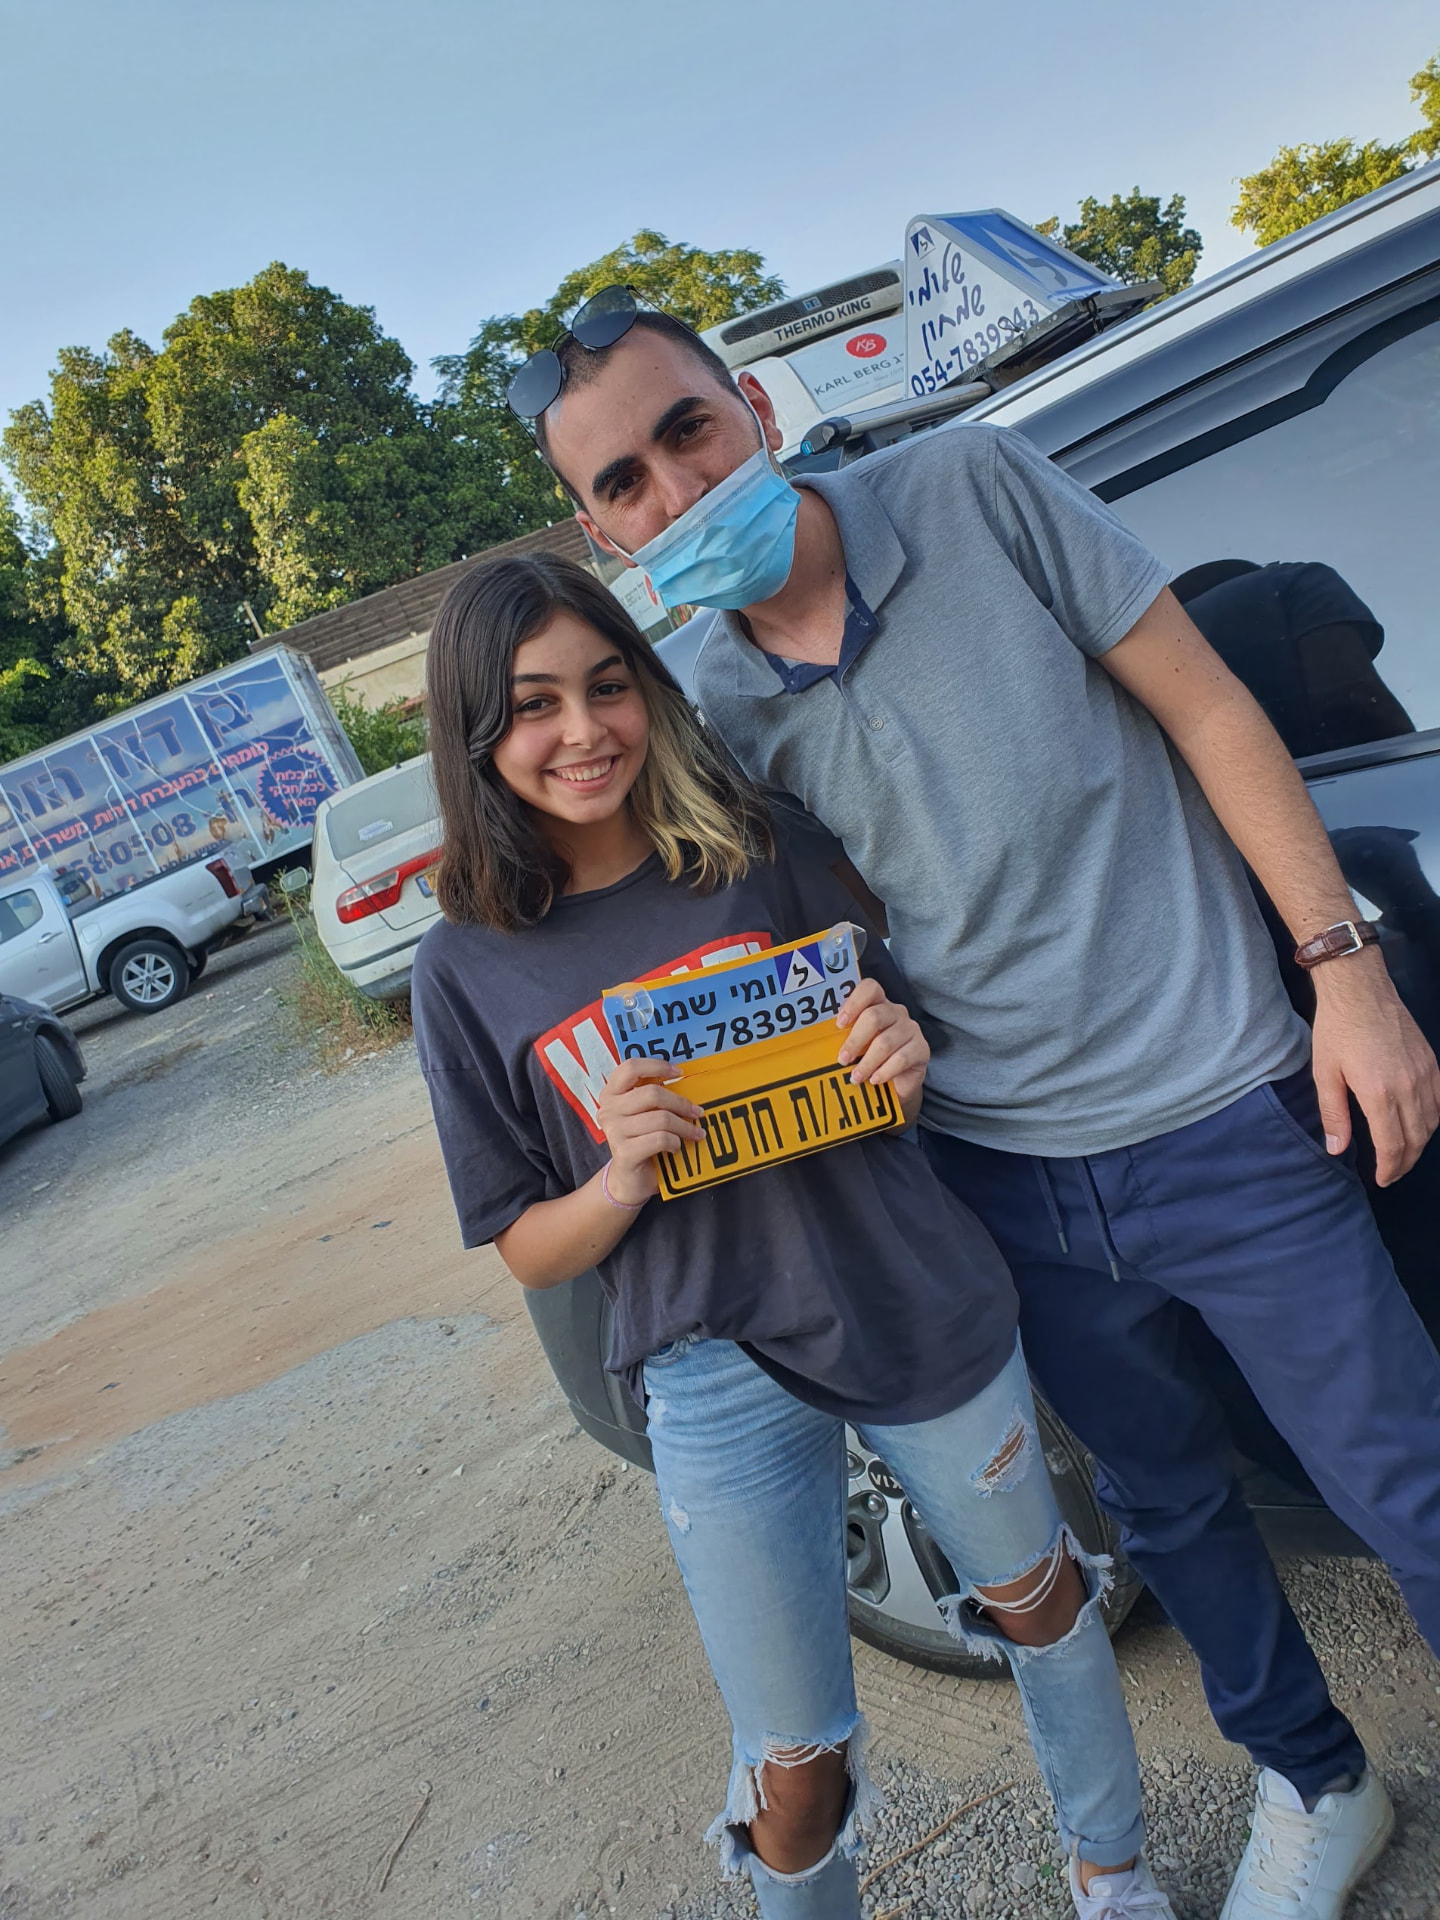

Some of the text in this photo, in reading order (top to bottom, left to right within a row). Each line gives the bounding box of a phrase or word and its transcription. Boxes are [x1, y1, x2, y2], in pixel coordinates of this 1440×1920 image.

[909, 241, 966, 307] שלומי
[774, 310, 836, 342] THERMO
[838, 297, 872, 319] KING
[855, 337, 877, 353] KB
[911, 299, 1041, 397] 054-7839343
[814, 375, 852, 395] KARL
[853, 360, 892, 379] BERG
[141, 766, 208, 806] בהעברת
